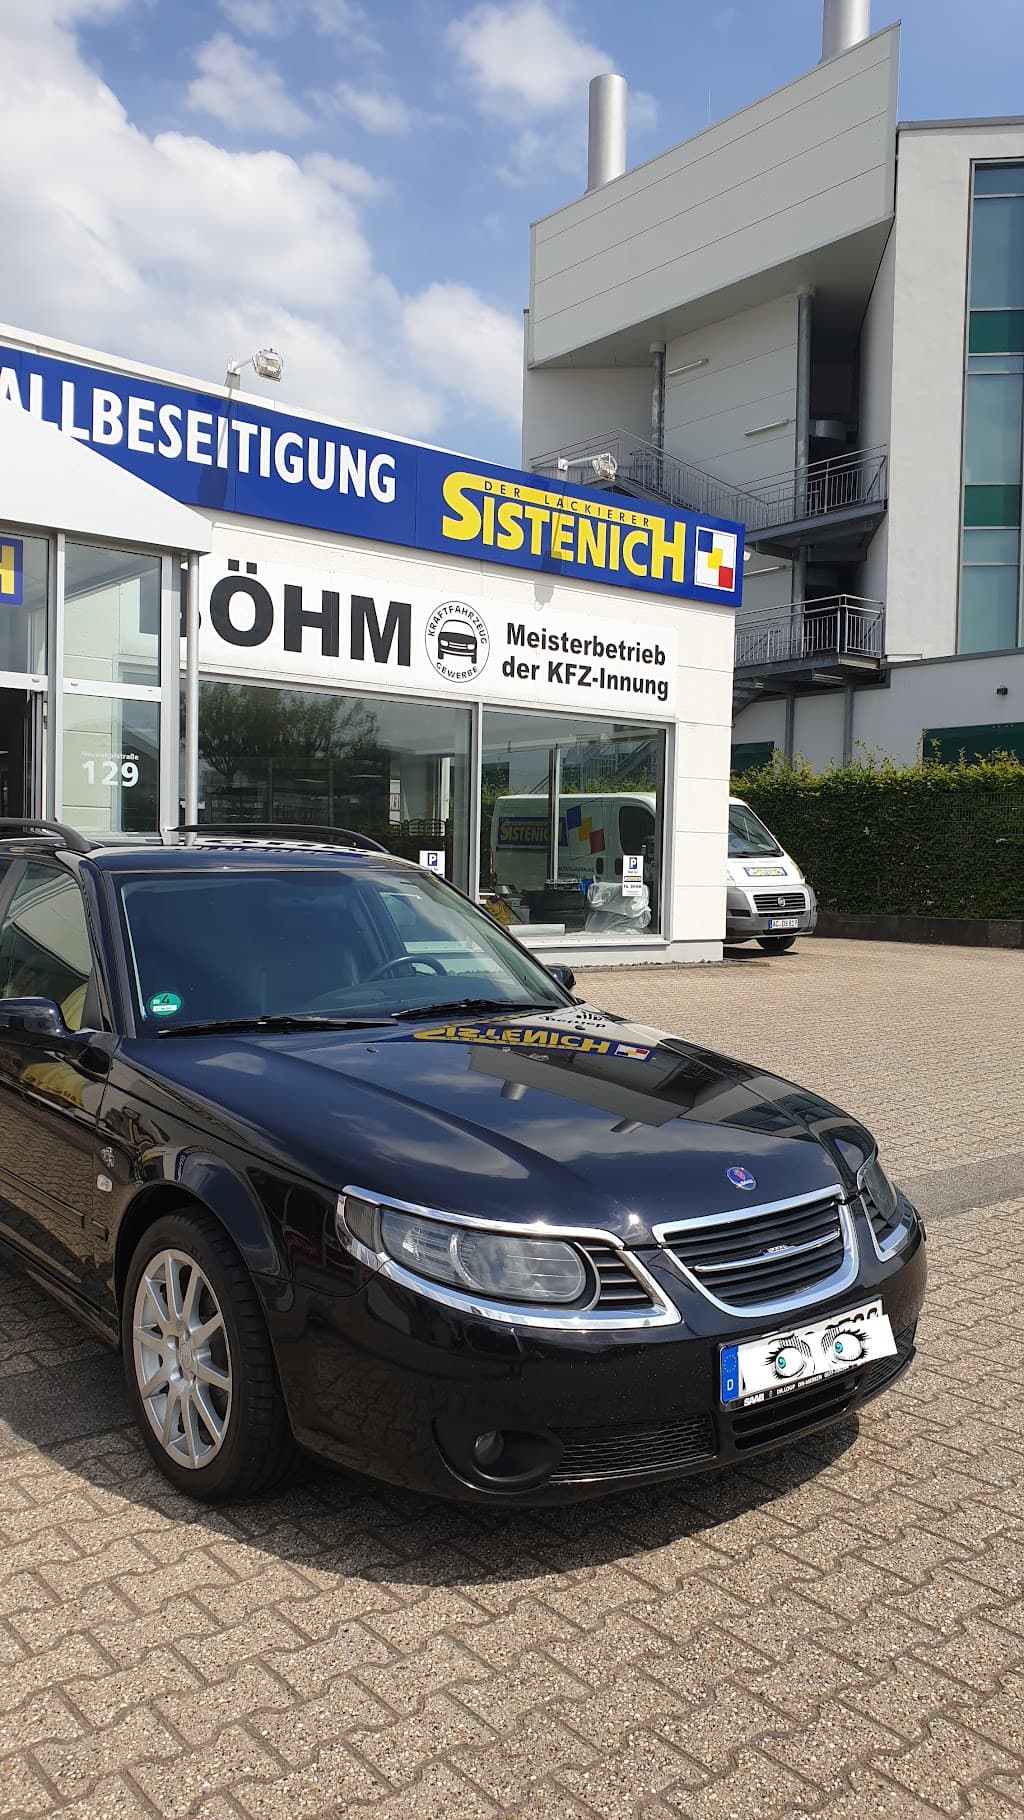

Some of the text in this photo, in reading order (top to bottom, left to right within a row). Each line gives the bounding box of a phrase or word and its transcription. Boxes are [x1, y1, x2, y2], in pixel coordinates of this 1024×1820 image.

[484, 479, 650, 528] DER LACKIERER
[441, 471, 686, 584] SISTENICH
[180, 559, 412, 667] ÖHM
[426, 604, 489, 645] KRAFTFAHRZEUG
[506, 622, 666, 666] Meisterbetrieb
[436, 661, 479, 680] GEWERBE
[502, 655, 669, 702] der KFZ-Innung
[82, 760, 139, 787] 129
[161, 994, 170, 1004] 4
[726, 1378, 734, 1391] D
[743, 1393, 765, 1407] SAAB
